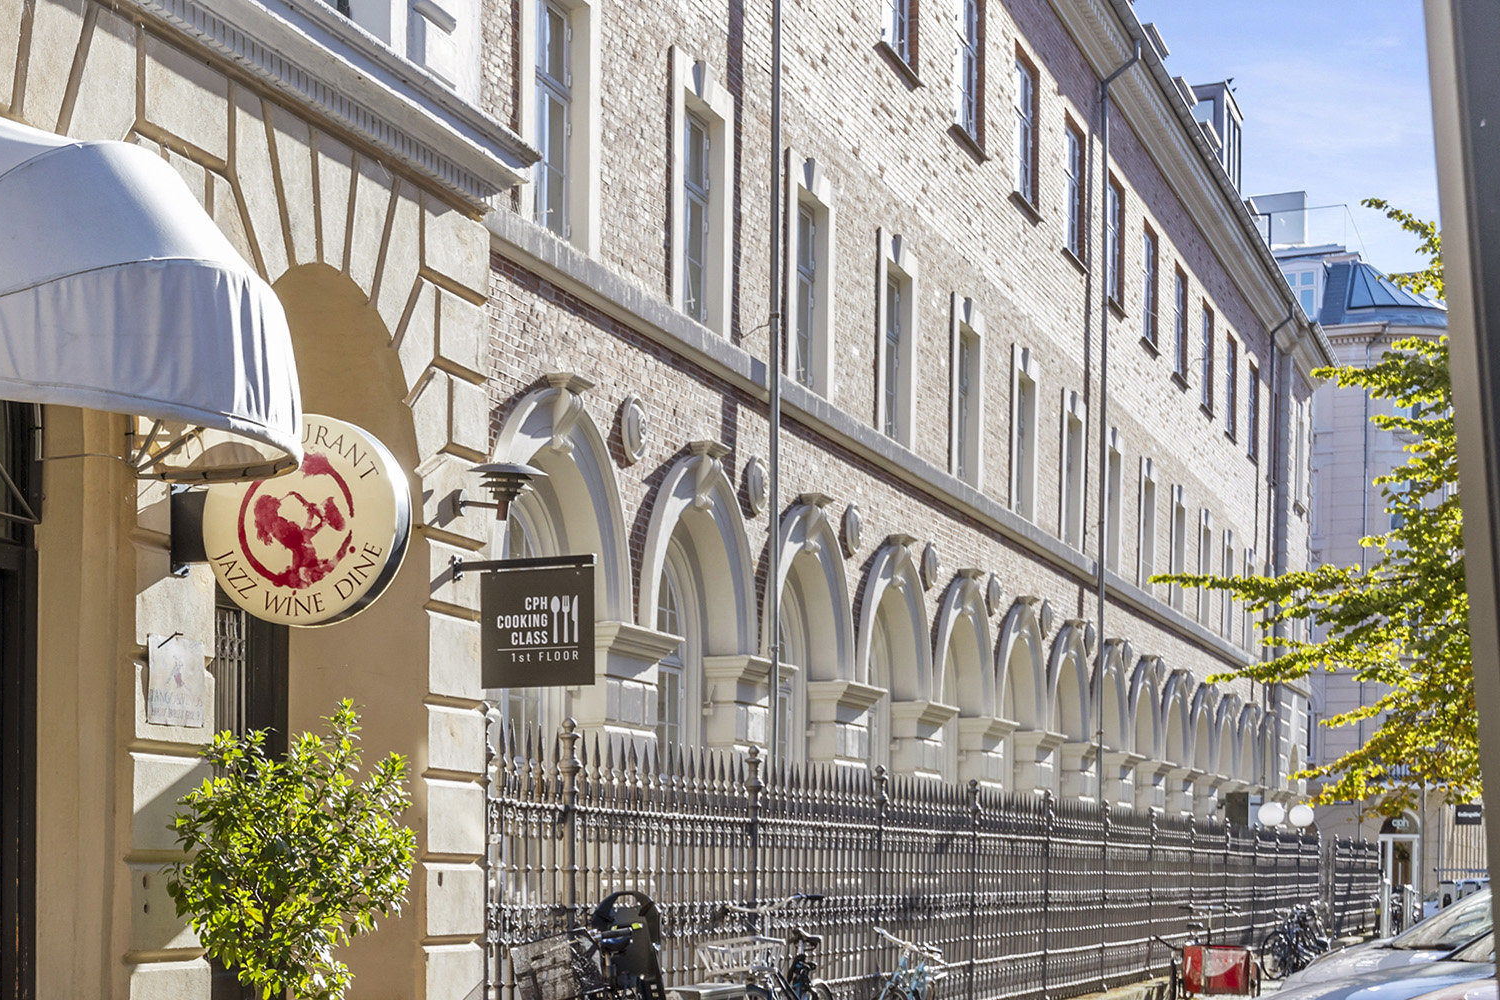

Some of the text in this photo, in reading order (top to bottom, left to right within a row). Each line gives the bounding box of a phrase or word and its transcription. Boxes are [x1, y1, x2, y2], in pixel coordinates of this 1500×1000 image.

[301, 424, 379, 480] URANT
[212, 542, 382, 617] JAZZ WINE DINE
[525, 595, 548, 611] CPH
[497, 613, 548, 629] COOKING
[511, 630, 548, 646] CLASS
[511, 650, 579, 662] 1st FLOOR
